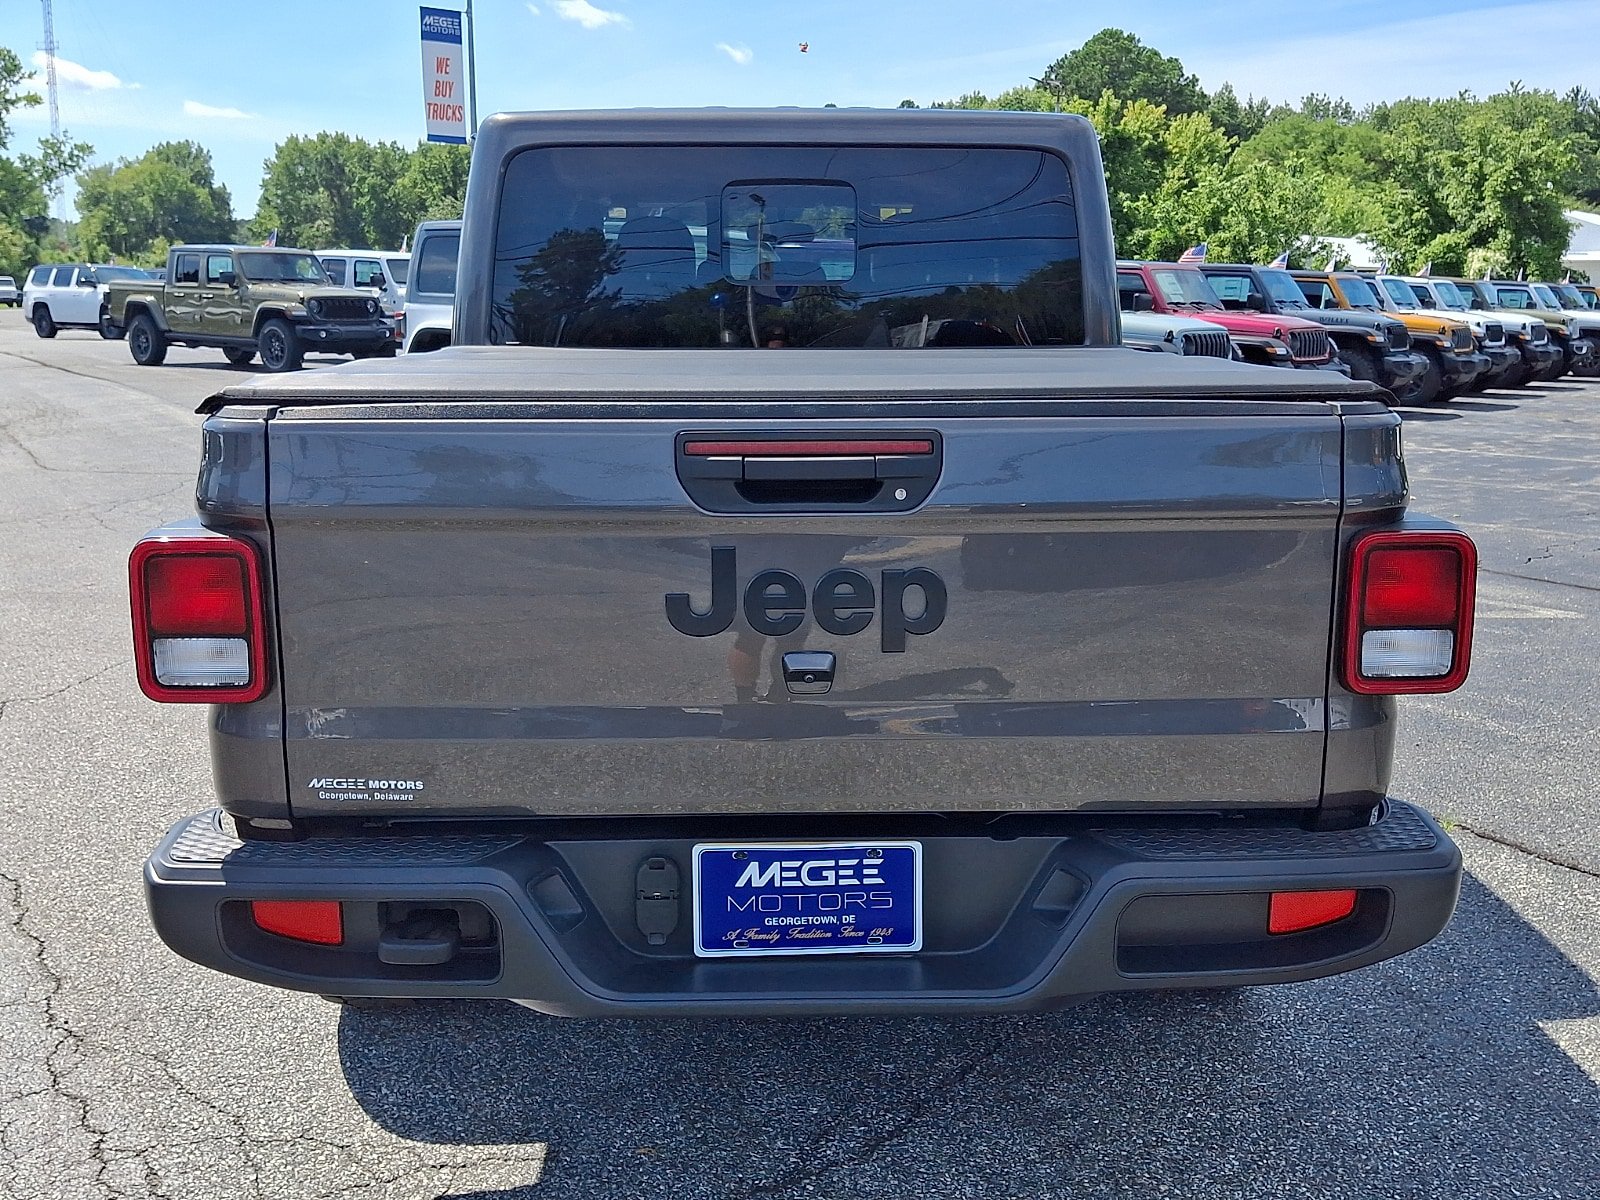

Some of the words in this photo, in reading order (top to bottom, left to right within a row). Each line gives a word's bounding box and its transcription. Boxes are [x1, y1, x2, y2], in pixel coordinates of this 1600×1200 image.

[422, 25, 461, 36] MOTORS
[423, 15, 460, 29] MEGEE
[436, 57, 450, 75] WE
[434, 80, 454, 98] BUY
[427, 102, 463, 122] TRUCKS
[665, 546, 947, 653] Jeep
[308, 778, 367, 789] MEGEE
[368, 780, 424, 790] MOTORS
[319, 791, 371, 801] Georgetown,
[374, 792, 414, 801] Delaware
[734, 858, 885, 888] MEGEE
[727, 891, 893, 912] MOTORS
[764, 916, 840, 926] GEORGETOWN,
[842, 915, 856, 924] DE
[722, 931, 738, 941] A
[741, 928, 781, 944] Family
[786, 926, 833, 940] Tradition
[837, 926, 865, 938] Since
[869, 927, 894, 938] 1948
